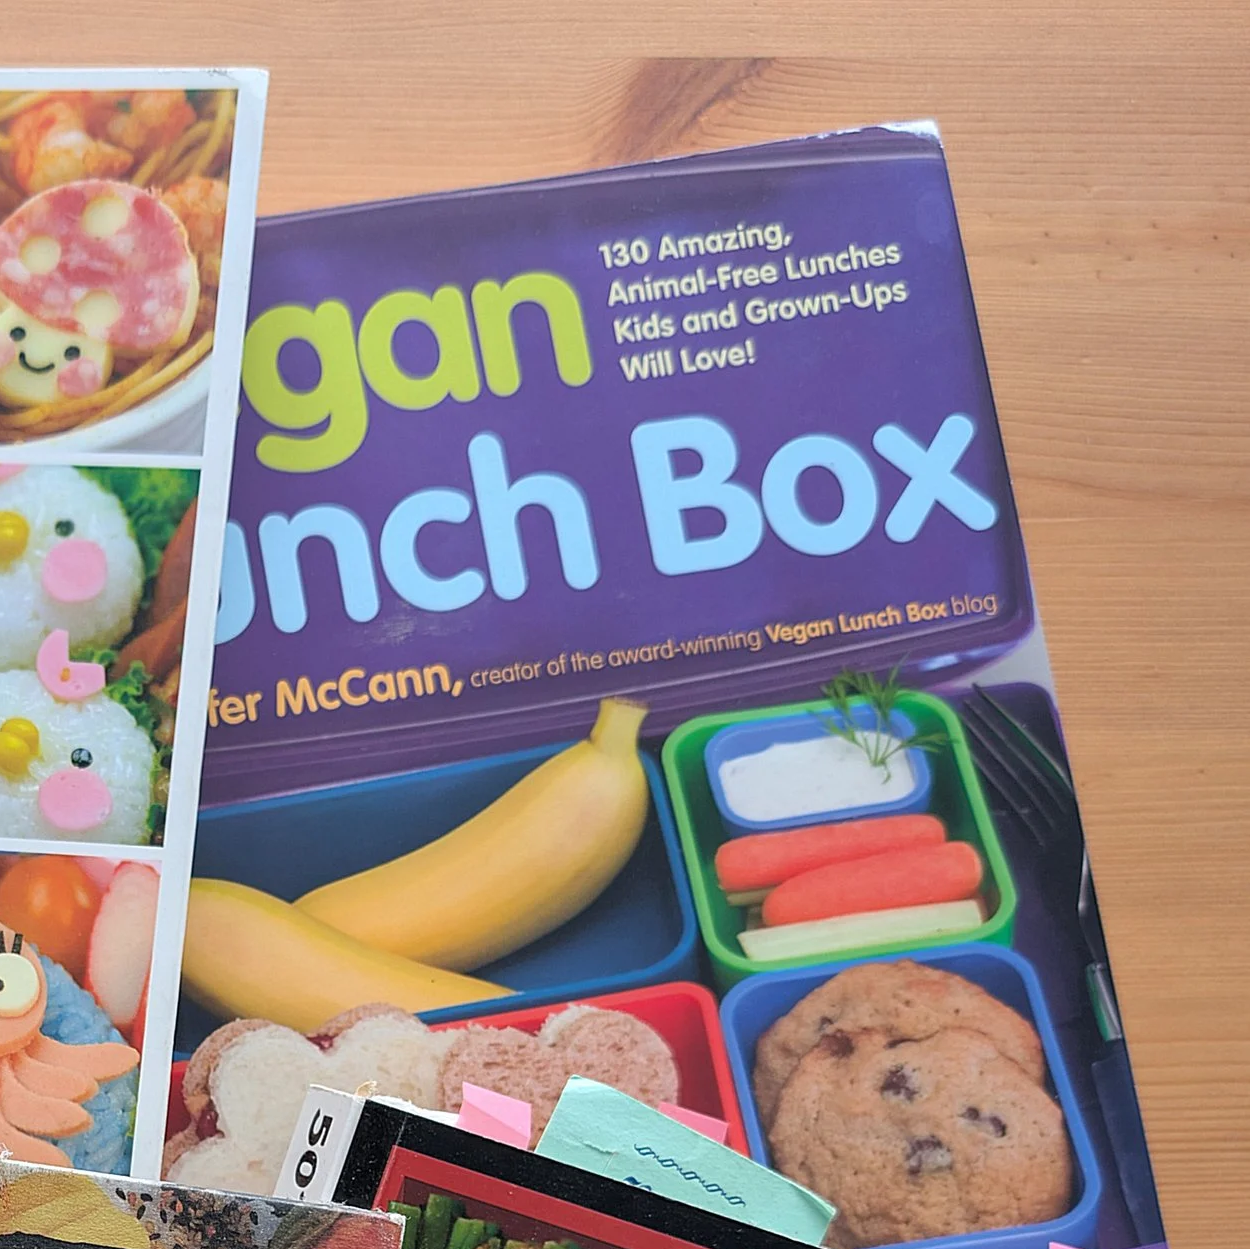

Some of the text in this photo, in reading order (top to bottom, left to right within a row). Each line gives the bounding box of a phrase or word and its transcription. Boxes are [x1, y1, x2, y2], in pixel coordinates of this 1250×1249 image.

[599, 222, 794, 269] 130 Amazing,
[608, 243, 901, 307] Animal-Free Lunches
[613, 281, 908, 344] Kids and Grown-Ups
[619, 340, 757, 381] Will Love!
[629, 412, 999, 576] Box
[276, 663, 464, 718] McCann,
[470, 658, 543, 689] creator
[546, 653, 569, 677] of
[570, 650, 603, 672] the
[608, 629, 763, 665] award-winning
[765, 617, 835, 646] Vegan
[838, 604, 902, 634] Lunch
[907, 600, 947, 624] Box
[950, 592, 998, 617] blog
[295, 1108, 333, 1200] 50
